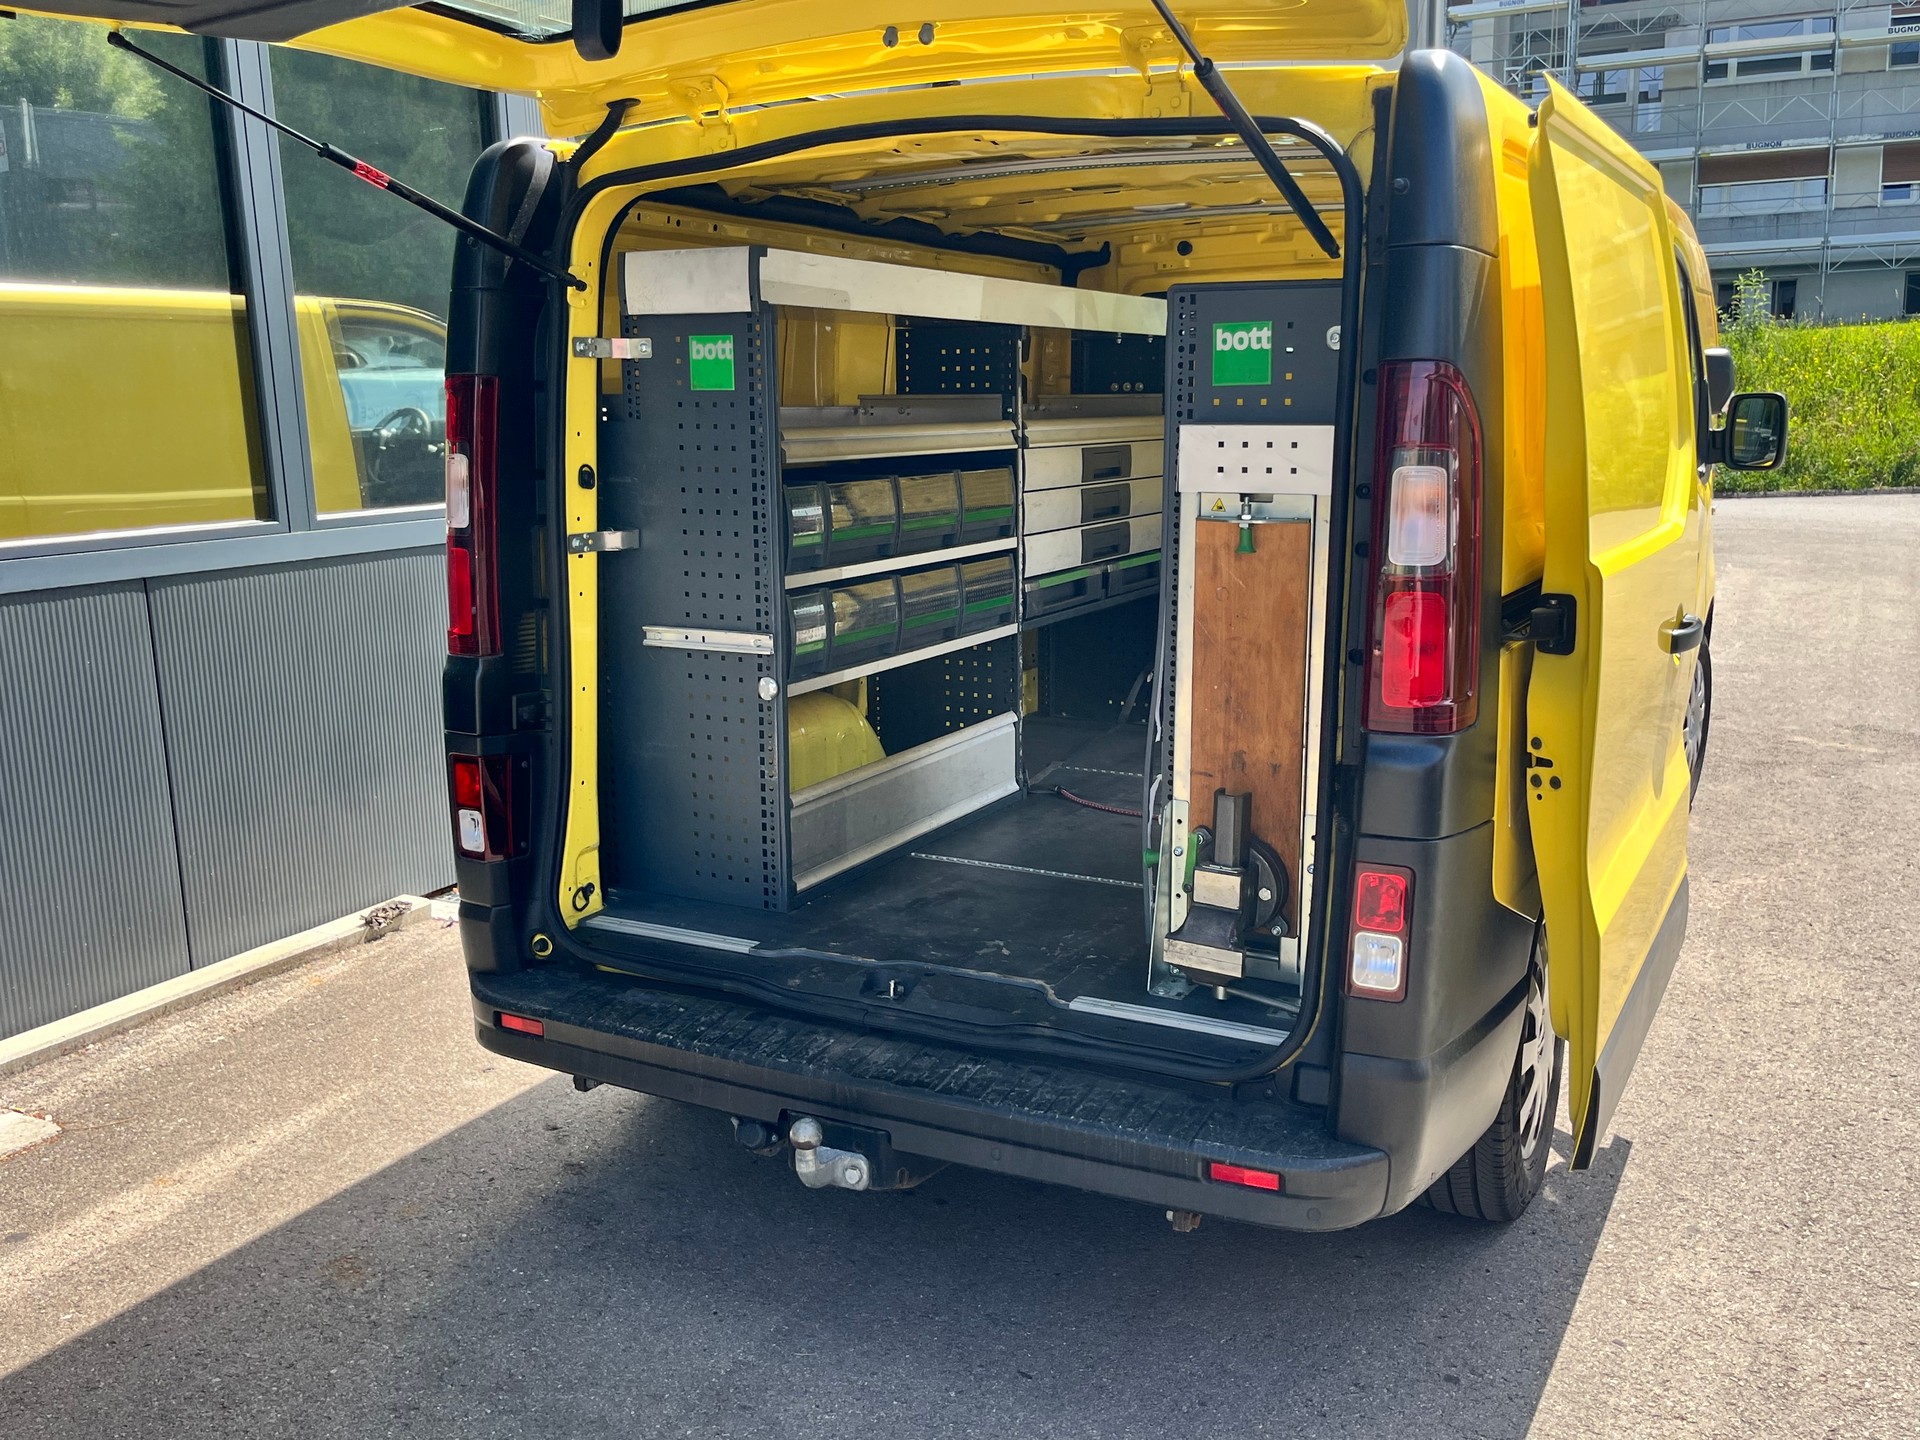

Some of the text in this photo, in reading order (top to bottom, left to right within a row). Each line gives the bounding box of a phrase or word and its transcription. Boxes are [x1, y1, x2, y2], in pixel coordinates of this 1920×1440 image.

[1746, 140, 1782, 150] BUGNON
[1216, 327, 1272, 351] bott
[691, 340, 734, 360] bott
